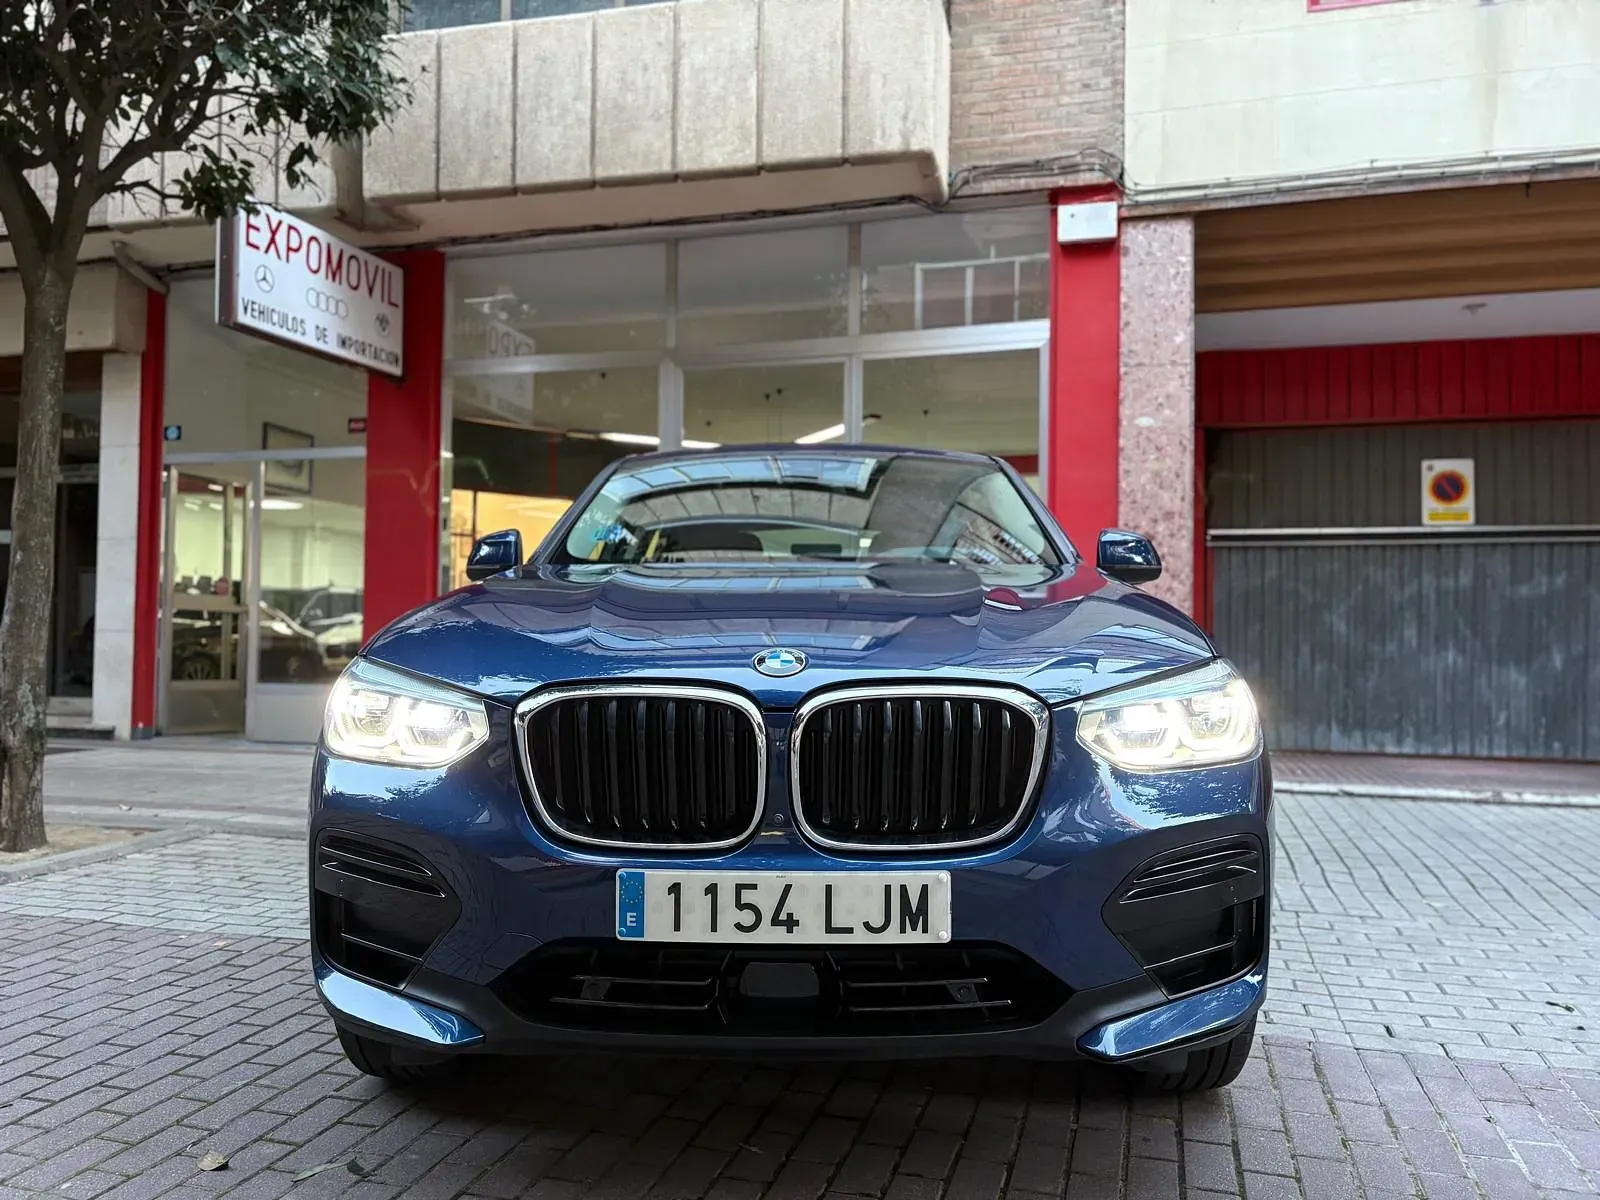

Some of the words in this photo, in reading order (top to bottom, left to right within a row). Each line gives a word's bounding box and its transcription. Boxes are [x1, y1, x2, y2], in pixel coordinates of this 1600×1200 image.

[246, 213, 400, 308] EXPOMOVIL
[242, 297, 307, 337] VEHICULOS
[315, 324, 329, 345] DE
[336, 332, 400, 367] IMPORTACION
[626, 912, 637, 928] E
[667, 882, 800, 934] 1154
[824, 883, 929, 935] LJM
